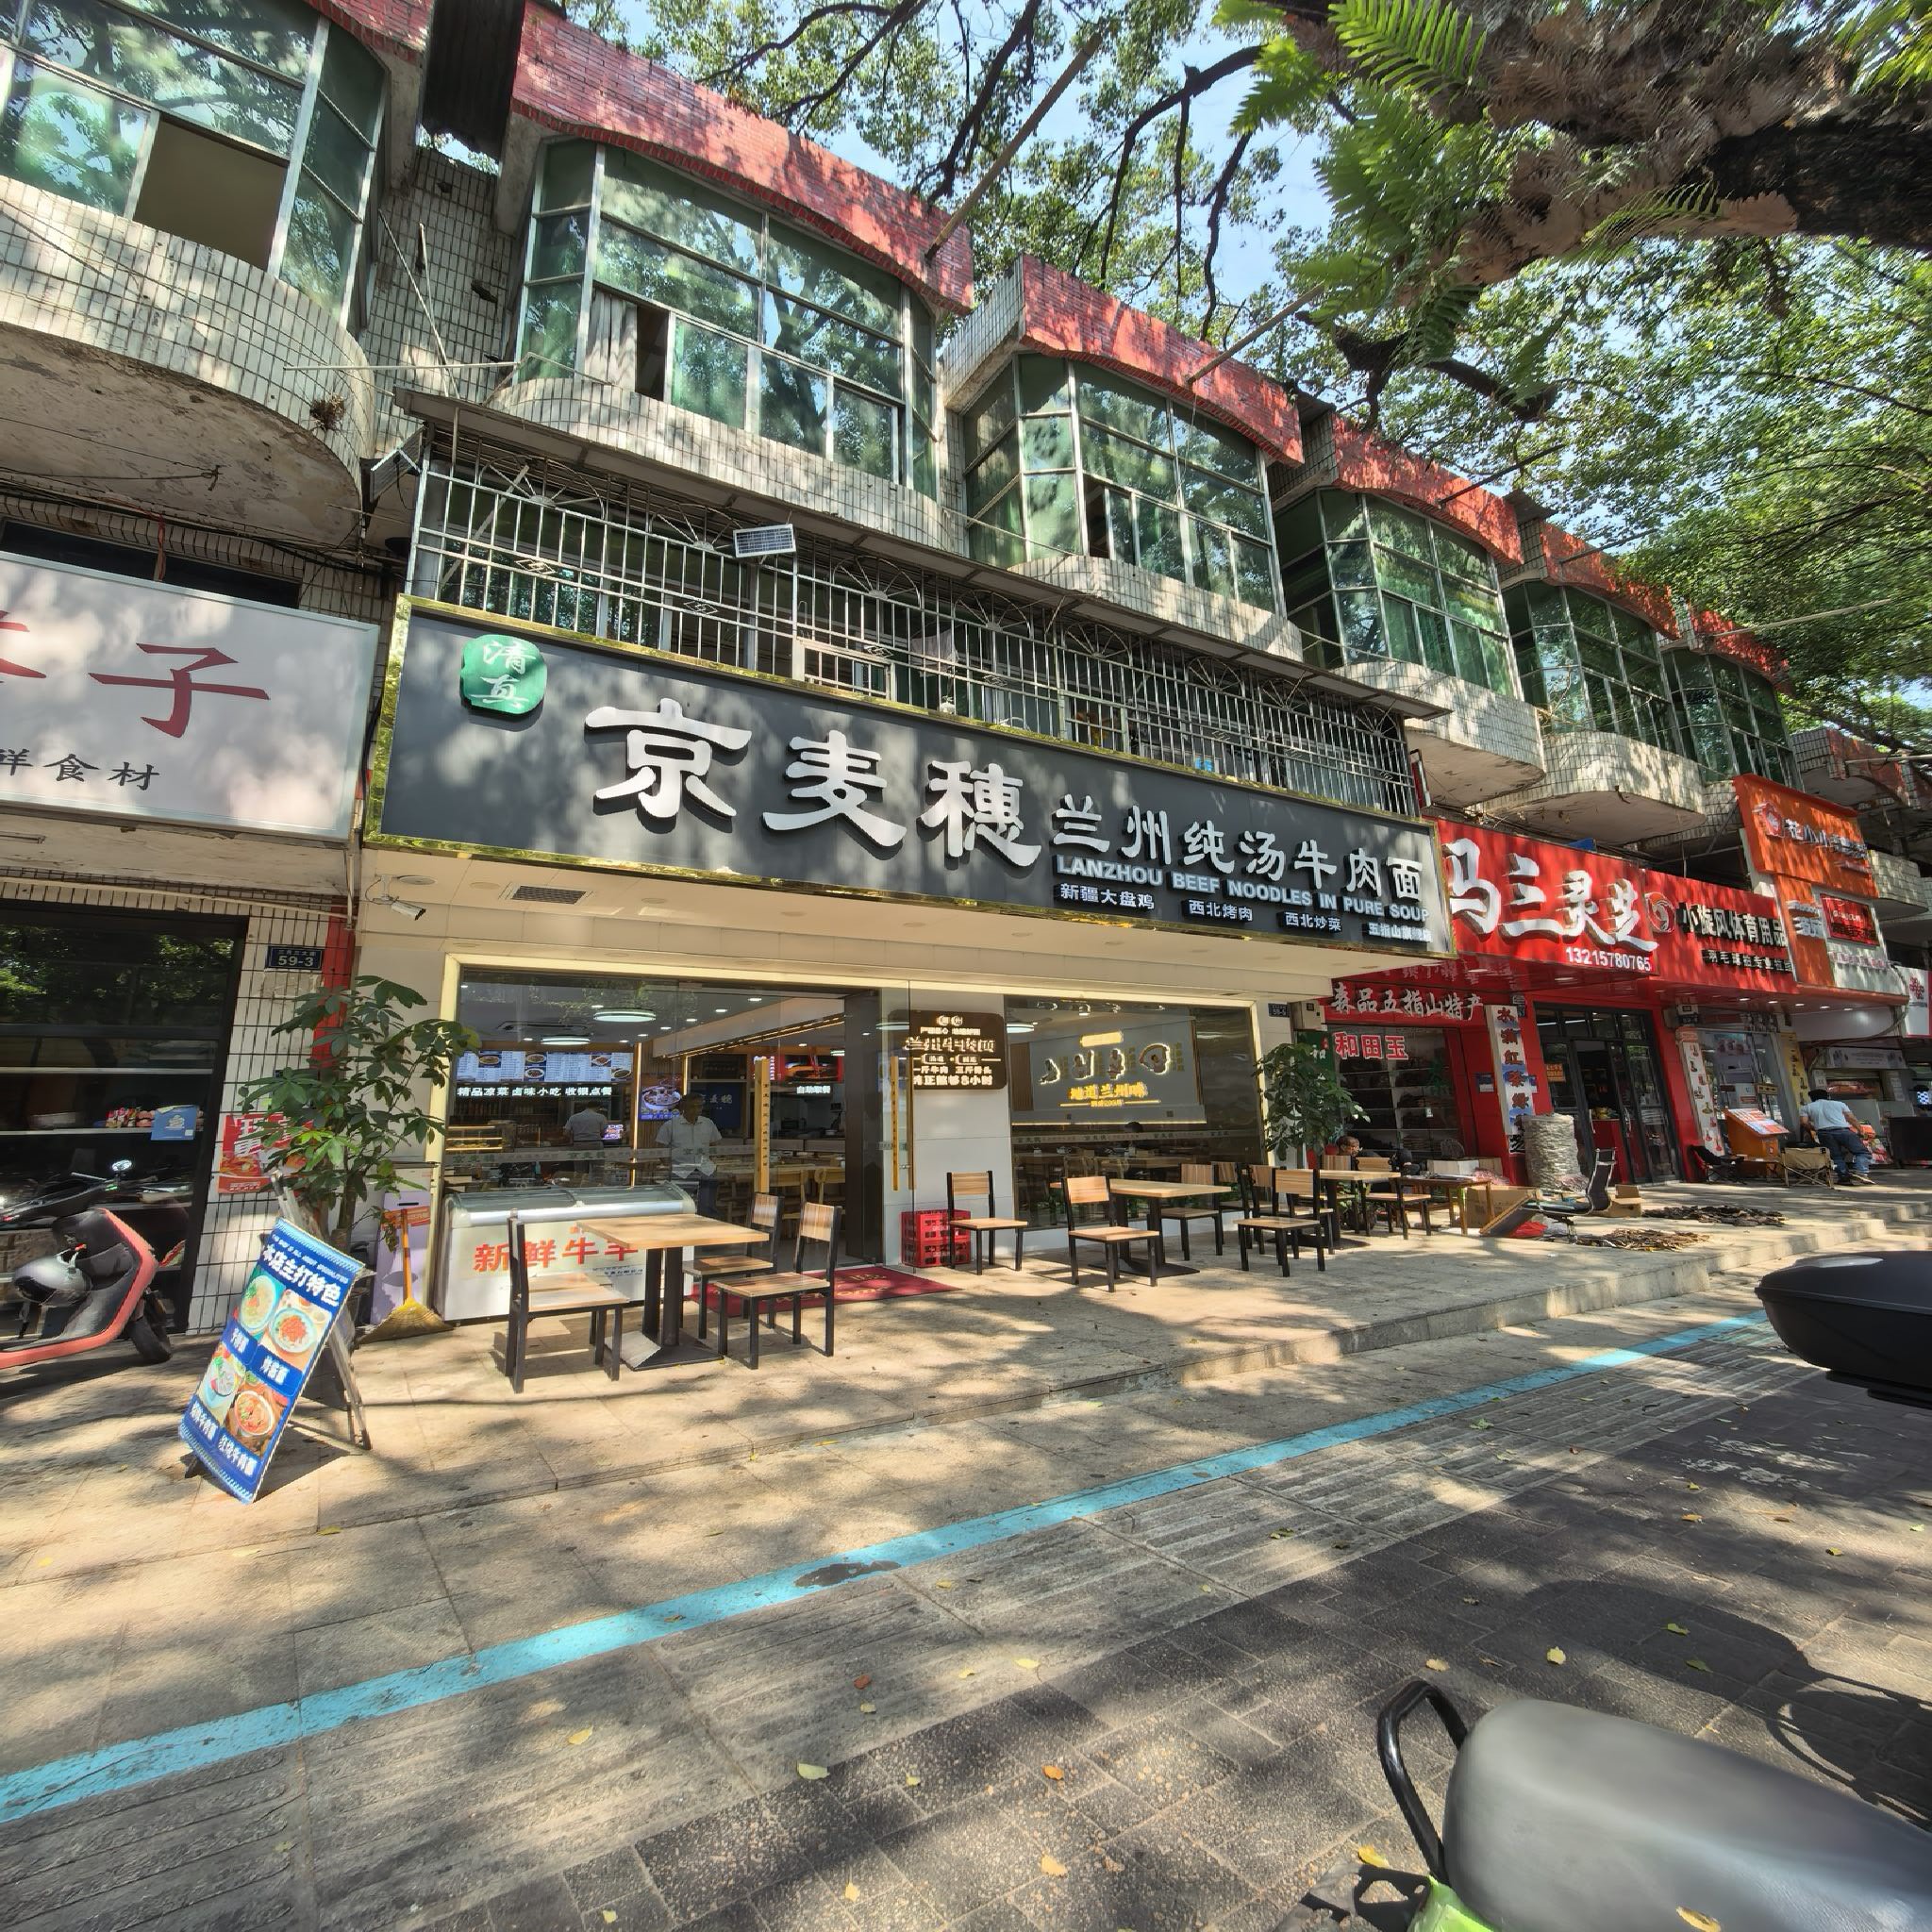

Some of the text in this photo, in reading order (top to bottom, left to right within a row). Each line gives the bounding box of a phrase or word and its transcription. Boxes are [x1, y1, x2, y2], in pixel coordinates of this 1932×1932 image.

[469, 641, 537, 708] 清真
[584, 698, 1041, 867] 京麦穗
[1053, 794, 1423, 900] 兰州纯汤牛肉面
[1057, 855, 1430, 922] LANZHOU BEEF NOODLES IN PURE SOUP
[1060, 883, 1155, 910] 新疆大盘鸡
[1442, 838, 1658, 952] 马三灵芝
[1189, 899, 1253, 922] 西北烤肉
[1285, 911, 1342, 932] 西北炒菜
[278, 956, 314, 967] 59-3
[1566, 946, 1651, 972] 13215780765
[1333, 1031, 1409, 1060] 和田玉
[512, 1087, 561, 1097] 卤味小吃
[263, 1244, 341, 1307] 本店主打特色
